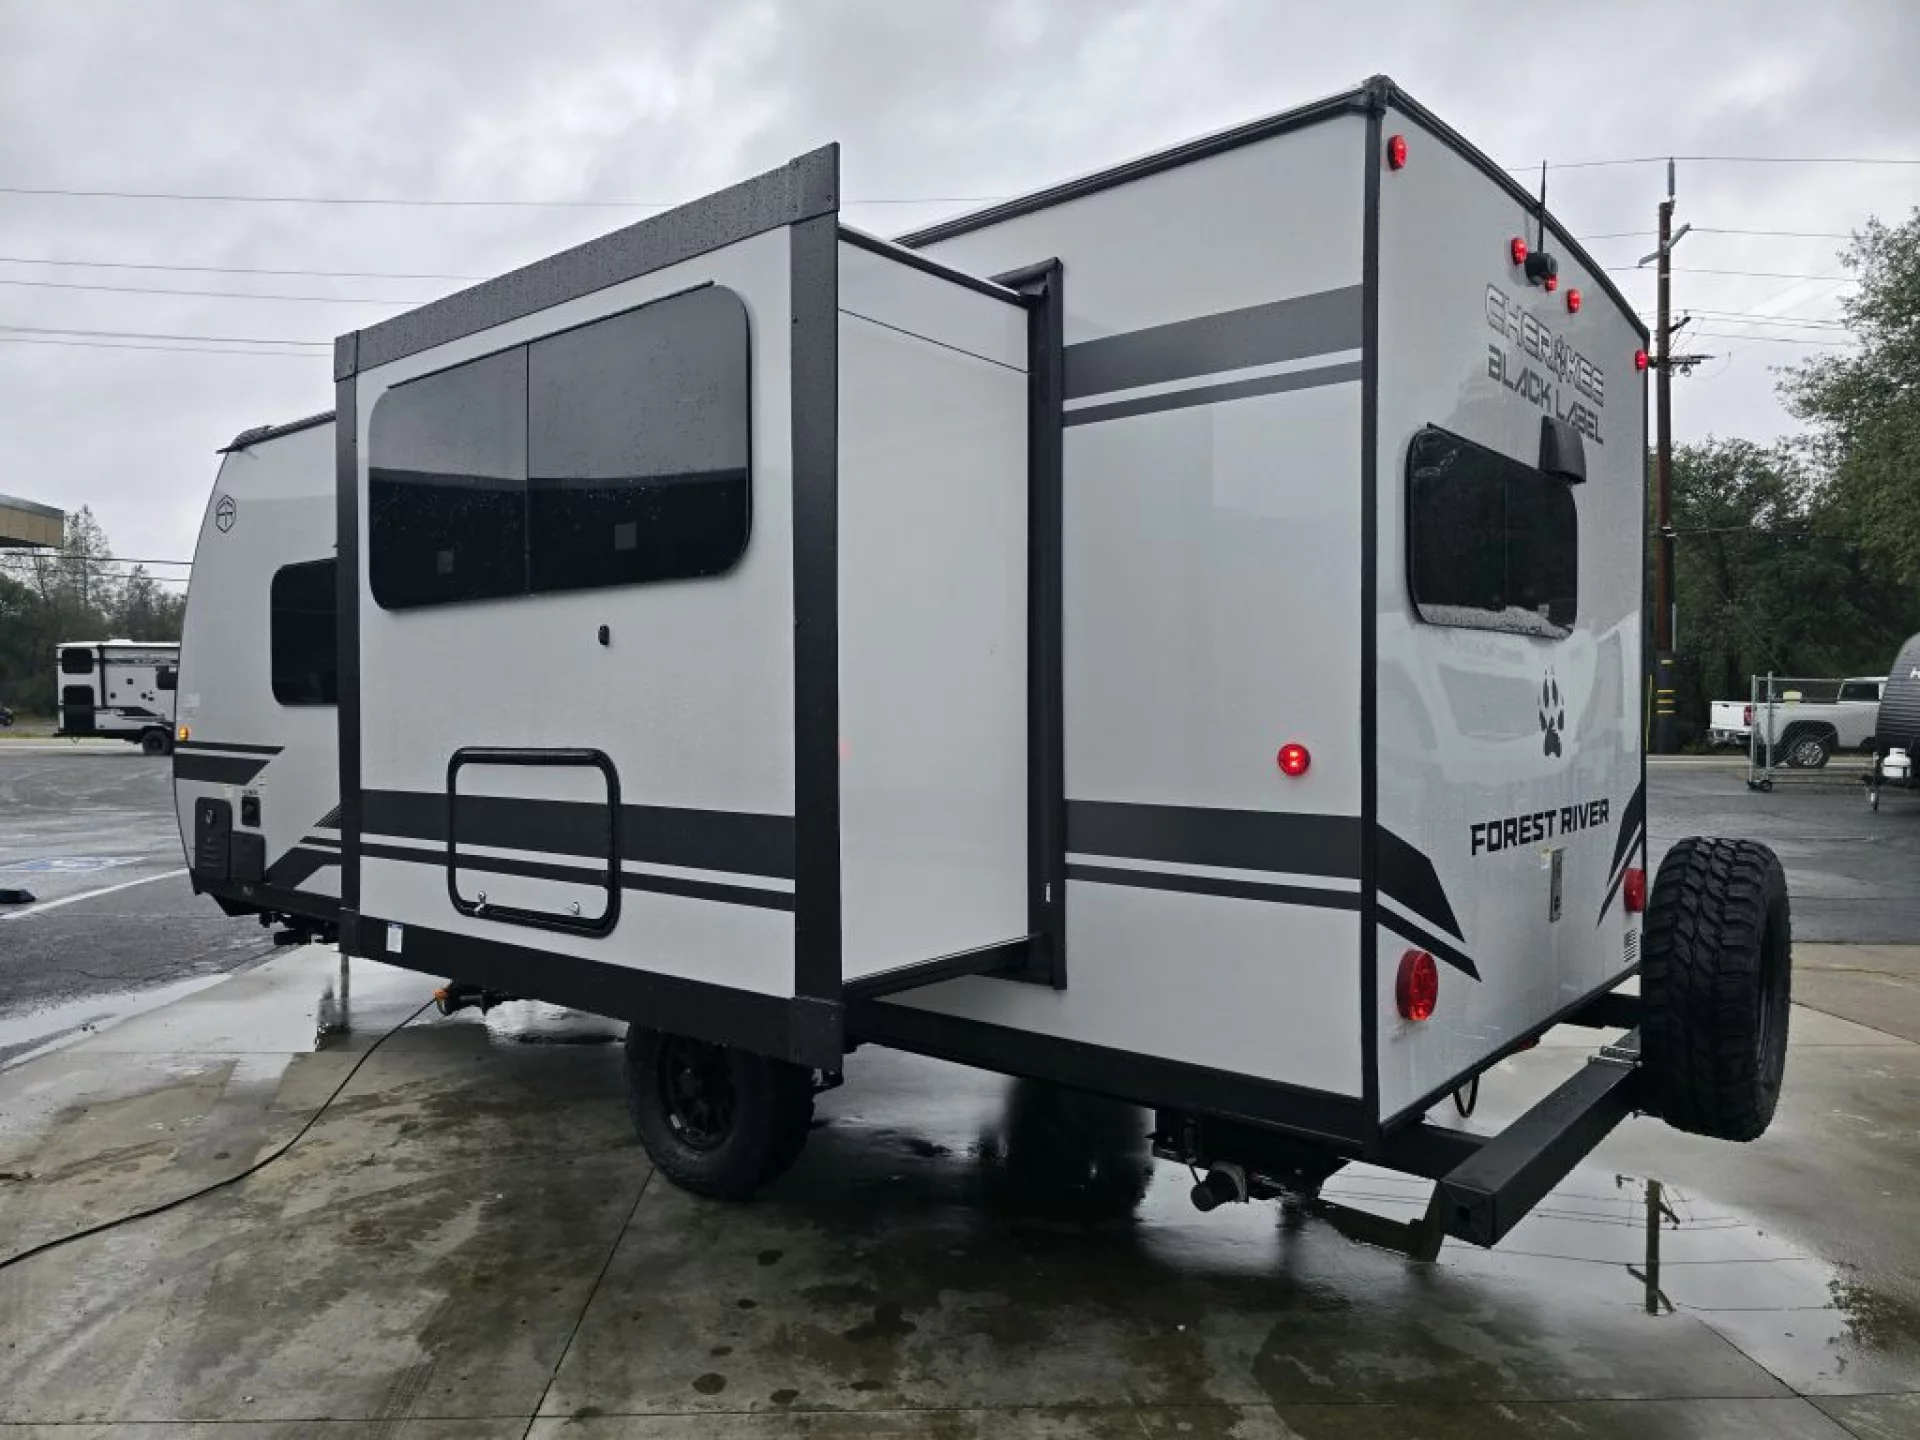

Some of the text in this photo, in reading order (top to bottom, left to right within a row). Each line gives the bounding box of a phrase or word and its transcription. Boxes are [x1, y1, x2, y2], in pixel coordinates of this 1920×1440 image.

[1488, 344, 1604, 445] BLACK LABEL
[1470, 798, 1610, 856] FOREST RIVER
